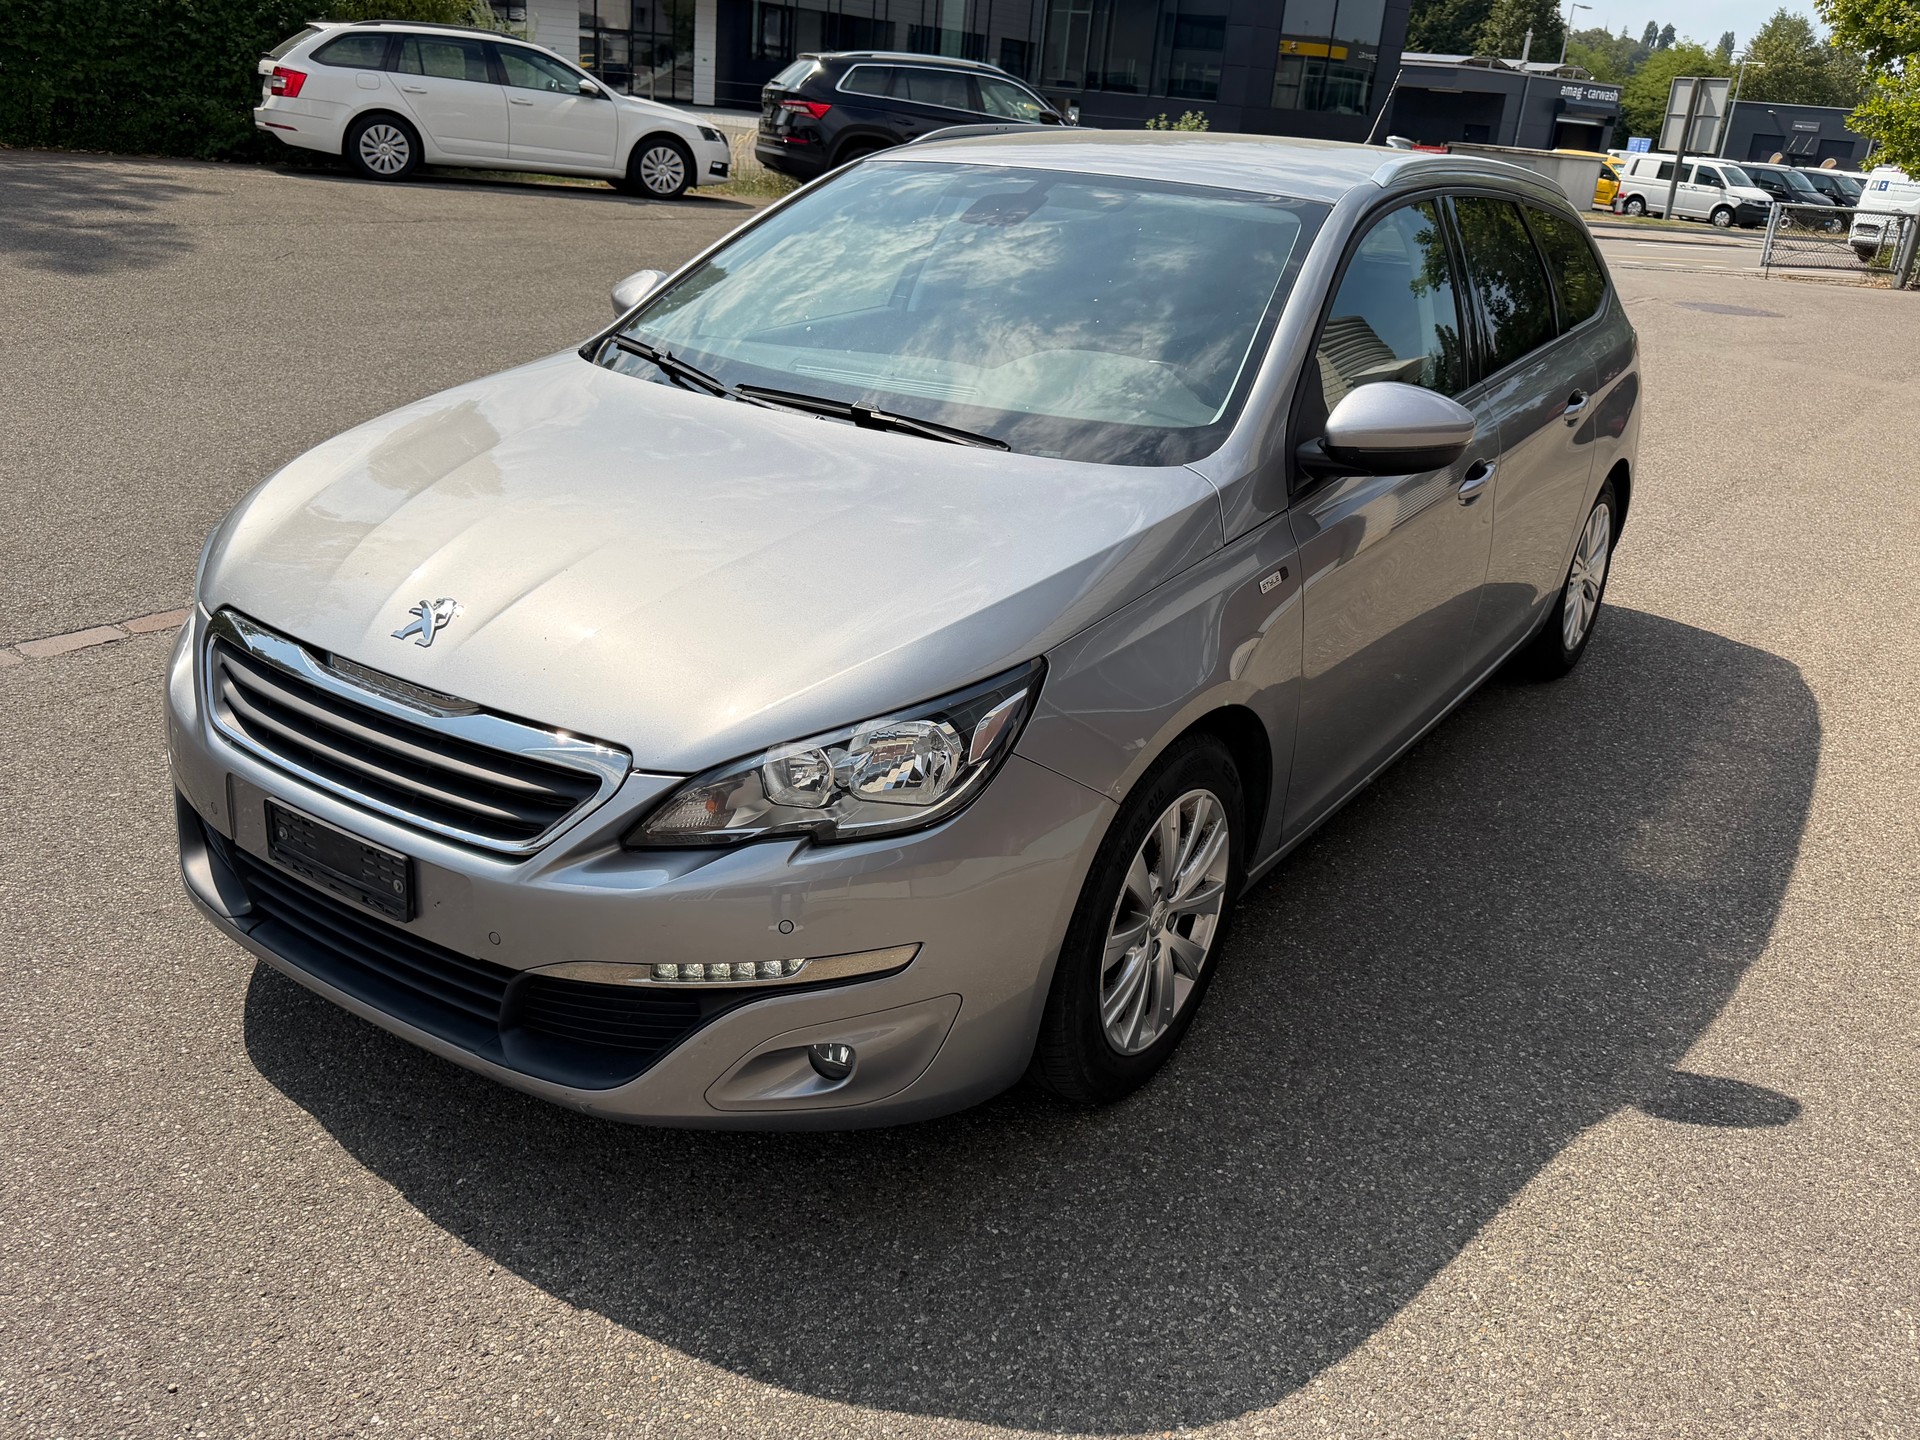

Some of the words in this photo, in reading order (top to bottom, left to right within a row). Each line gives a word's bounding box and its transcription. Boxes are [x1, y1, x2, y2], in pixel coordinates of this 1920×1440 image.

[1561, 86, 1583, 100] amag
[1588, 90, 1618, 102] carwash
[1263, 576, 1280, 590] STYLE
